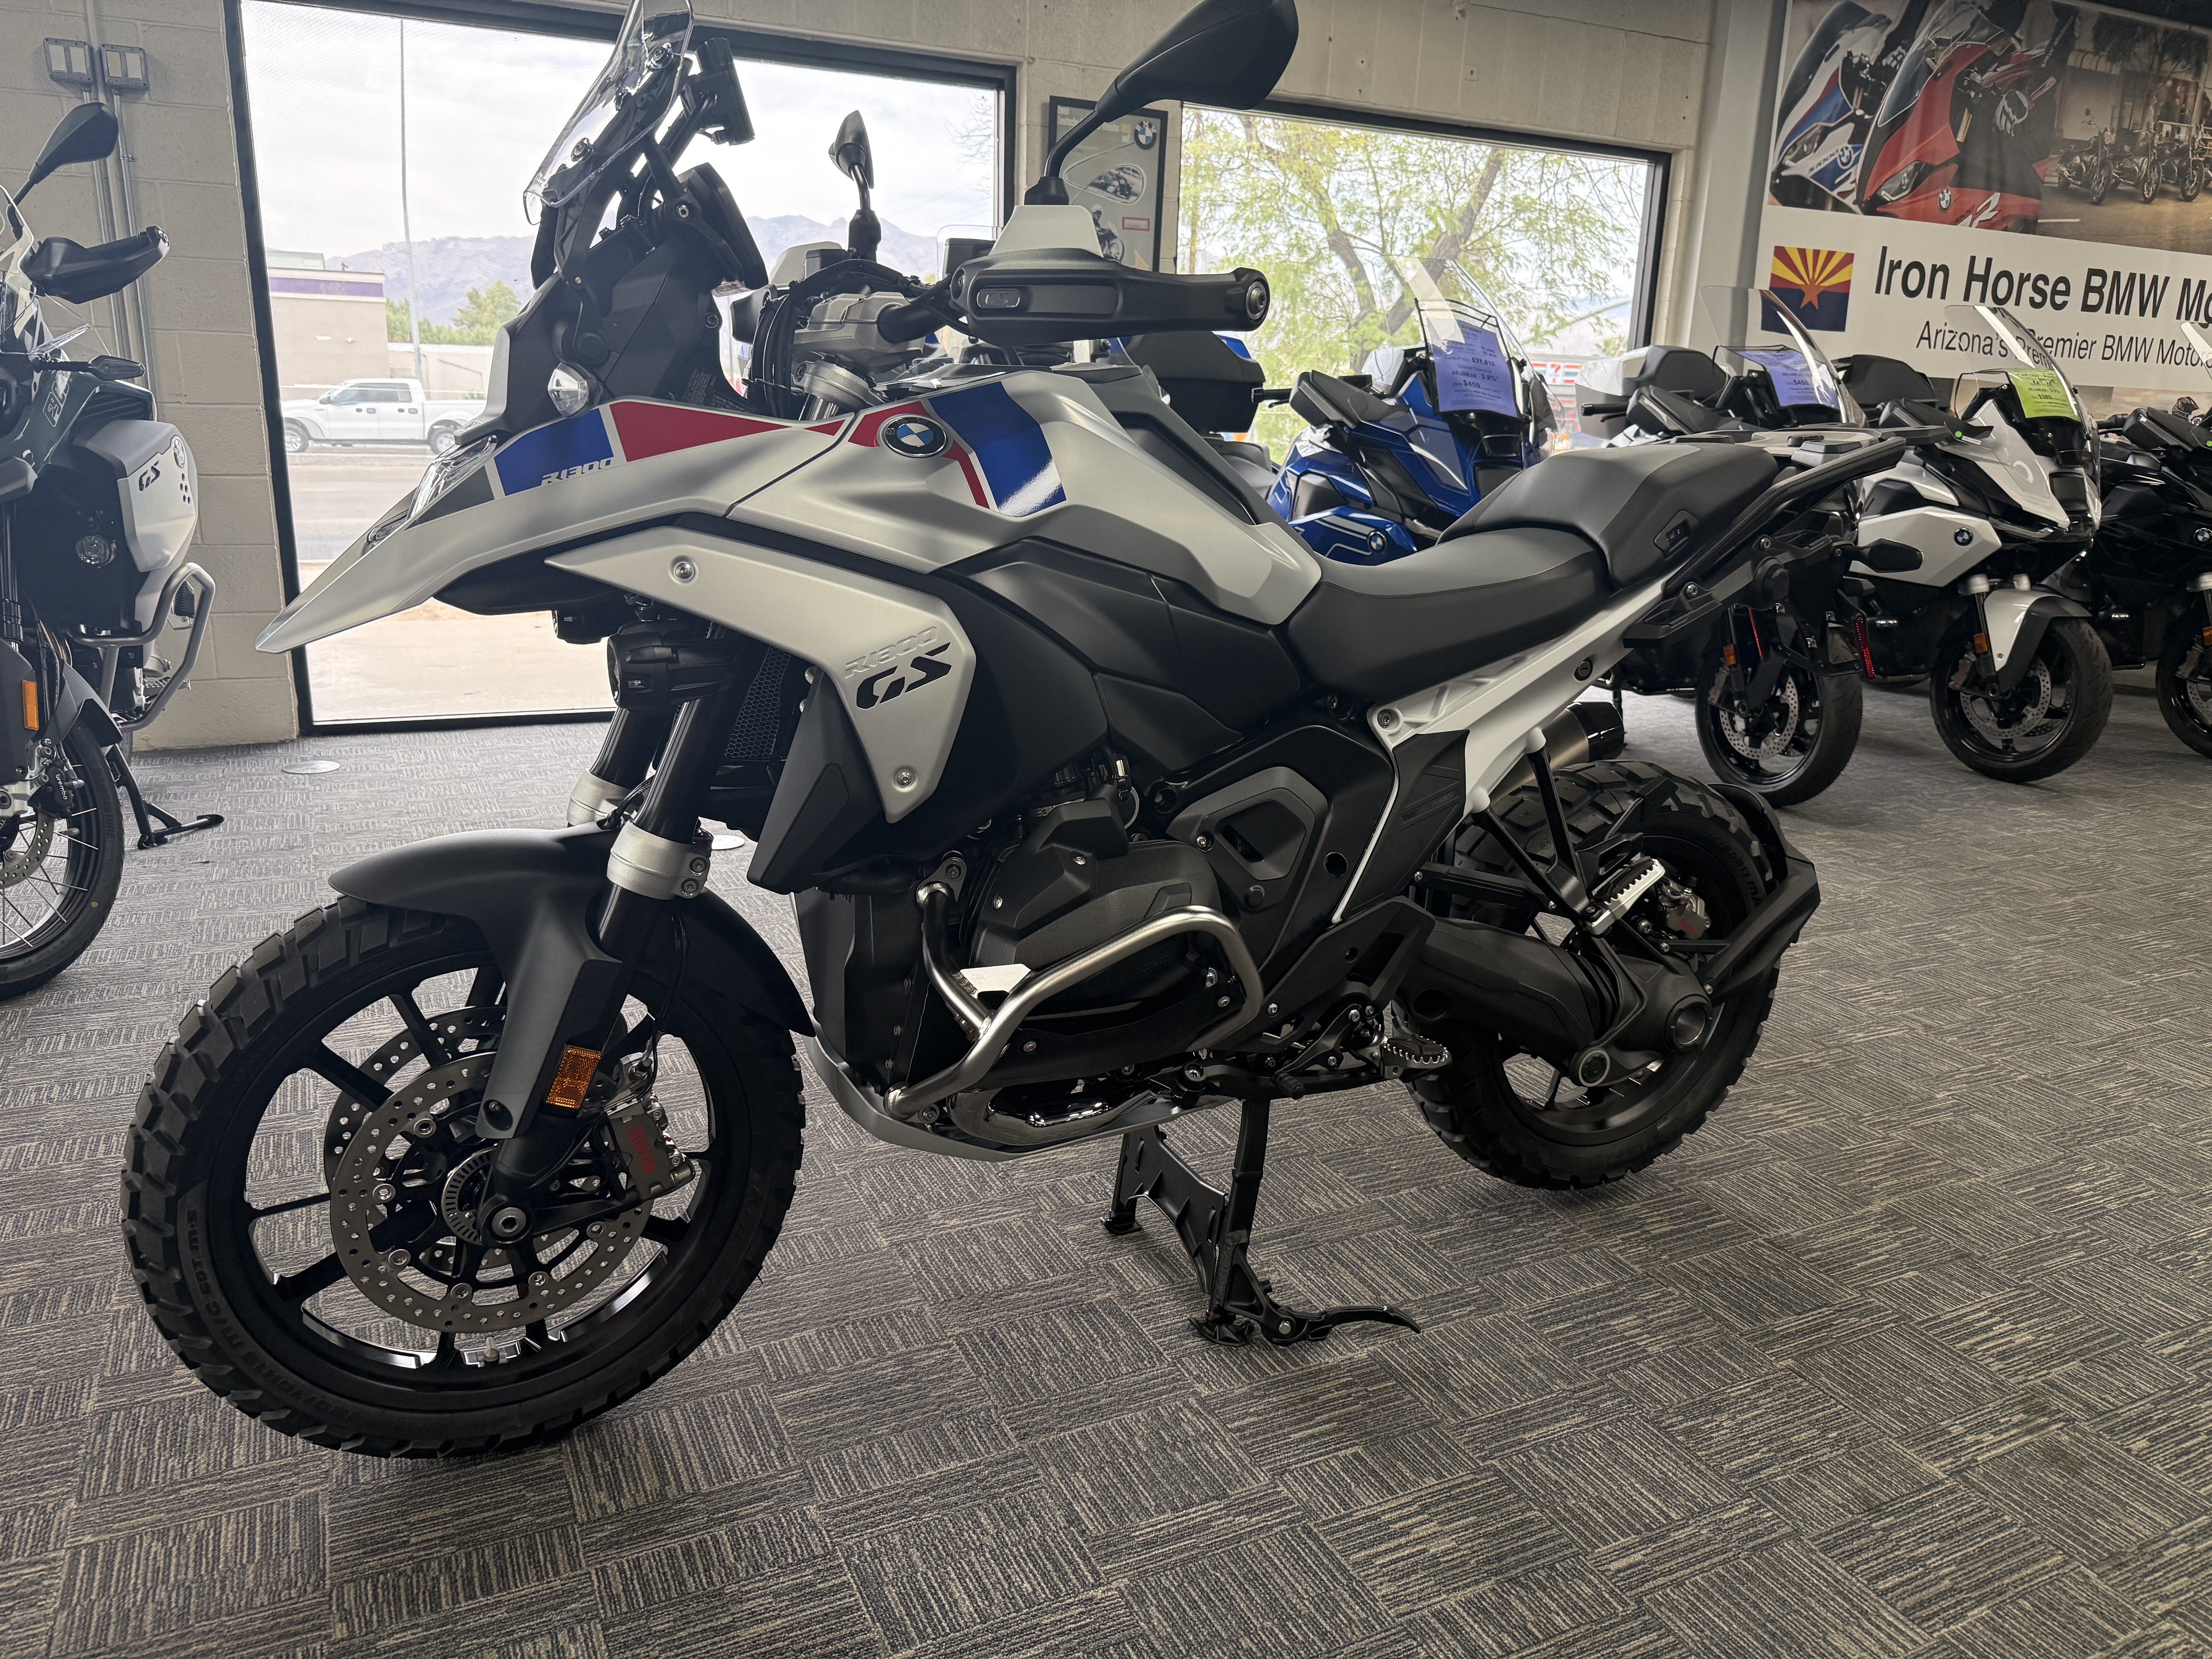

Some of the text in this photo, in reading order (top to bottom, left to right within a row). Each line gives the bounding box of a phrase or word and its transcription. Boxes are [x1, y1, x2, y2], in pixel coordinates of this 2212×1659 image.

[1875, 246, 1950, 300] Iron
[1963, 255, 2071, 311] Horse
[2081, 268, 2171, 318] BMW
[1915, 321, 2008, 358] Arizona's
[2101, 334, 2154, 363] BMW
[1463, 380, 1480, 389] $459
[139, 459, 161, 492] GS
[541, 457, 614, 486] R1300
[845, 626, 937, 679] R1300
[856, 642, 952, 710] GS
[55, 774, 67, 800] brembo
[627, 1125, 660, 1174] BMW
